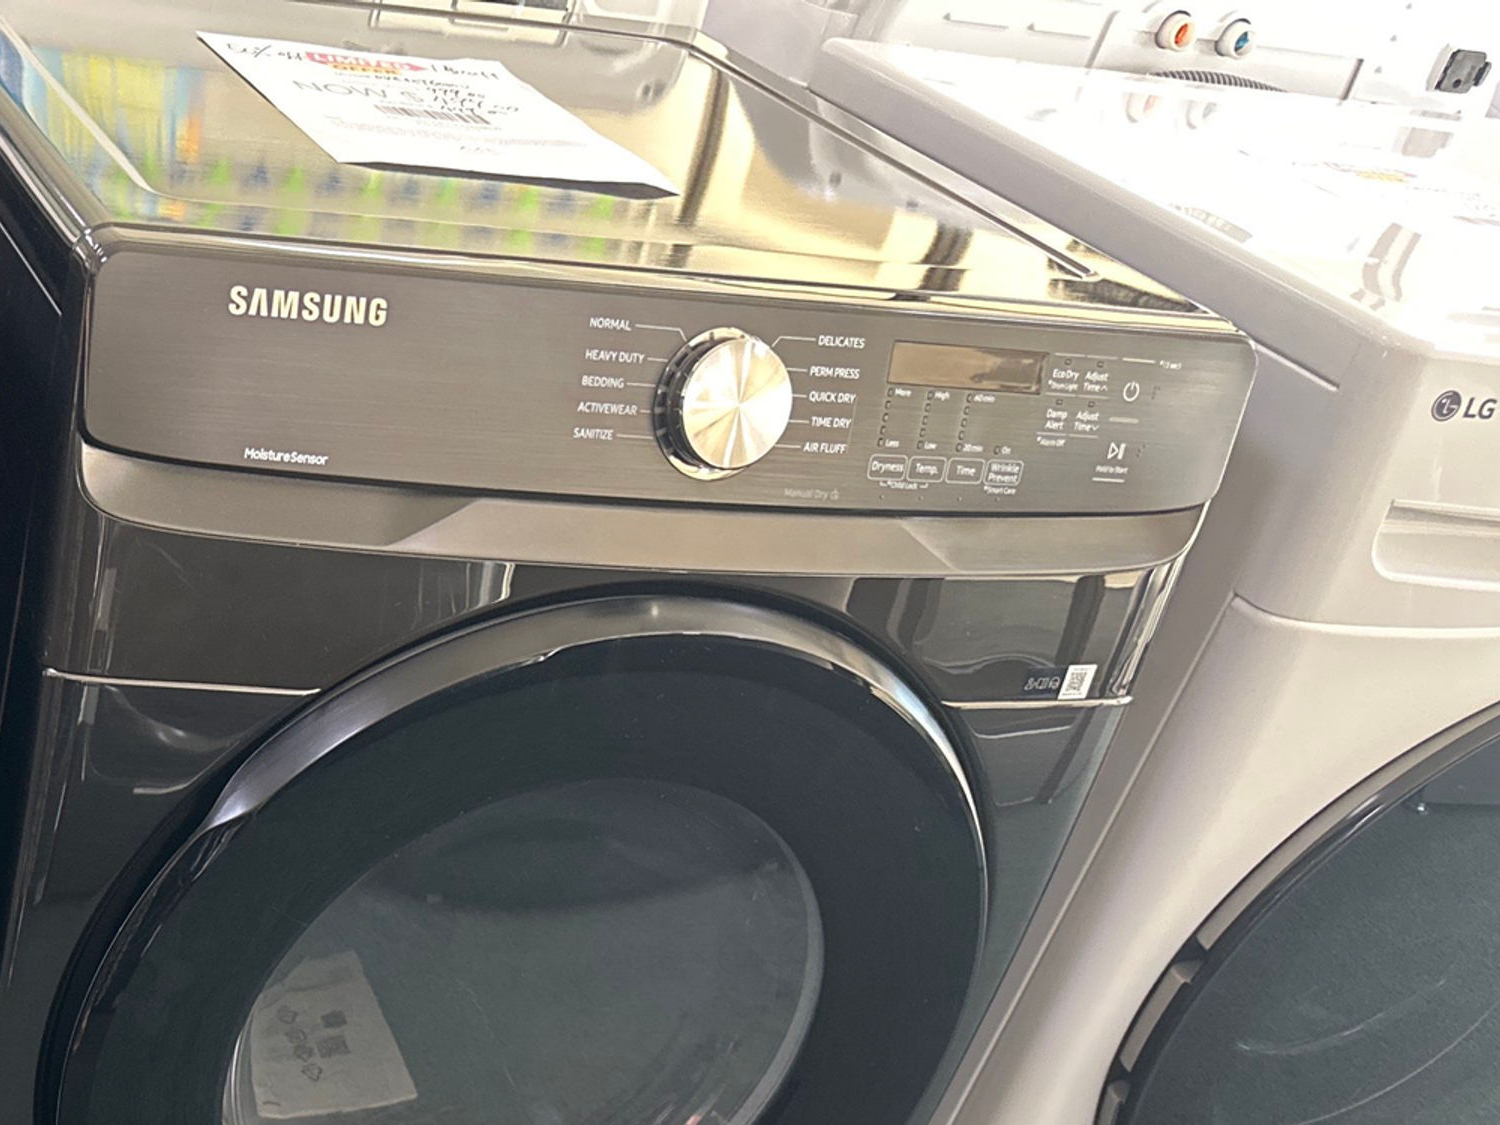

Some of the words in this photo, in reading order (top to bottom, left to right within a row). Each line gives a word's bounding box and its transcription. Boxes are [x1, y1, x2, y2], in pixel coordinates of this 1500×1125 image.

[292, 79, 388, 99] NOW
[228, 285, 388, 327] SAMSUNG
[589, 317, 632, 331] NORMAL
[818, 335, 865, 349] DELICATES
[585, 349, 617, 361] HEAVY
[619, 352, 645, 363] DUTY
[809, 366, 833, 377] PERM
[833, 368, 860, 379] PRESS
[1084, 371, 1109, 383] Adjust
[581, 375, 624, 388] BEDDING
[1083, 382, 1101, 392] Time
[808, 391, 833, 403] QUICK
[834, 393, 856, 405] DRY
[577, 402, 637, 415] ACTIVEWEAR
[1046, 408, 1068, 421] Damp
[1462, 397, 1497, 419] LG
[811, 416, 832, 427] TIME
[833, 418, 852, 429] DRY
[1075, 411, 1100, 422] Adjust
[1044, 420, 1064, 430] Alert
[1074, 421, 1092, 432] Time
[573, 427, 613, 440] SANITIZE
[803, 443, 819, 453] AIR
[820, 442, 847, 454] FLUFF
[871, 460, 904, 474] Dryness
[915, 462, 938, 476] Temp.
[956, 465, 976, 476] Time
[990, 463, 1020, 474] Wrinkle
[987, 472, 1018, 483] Prevent
